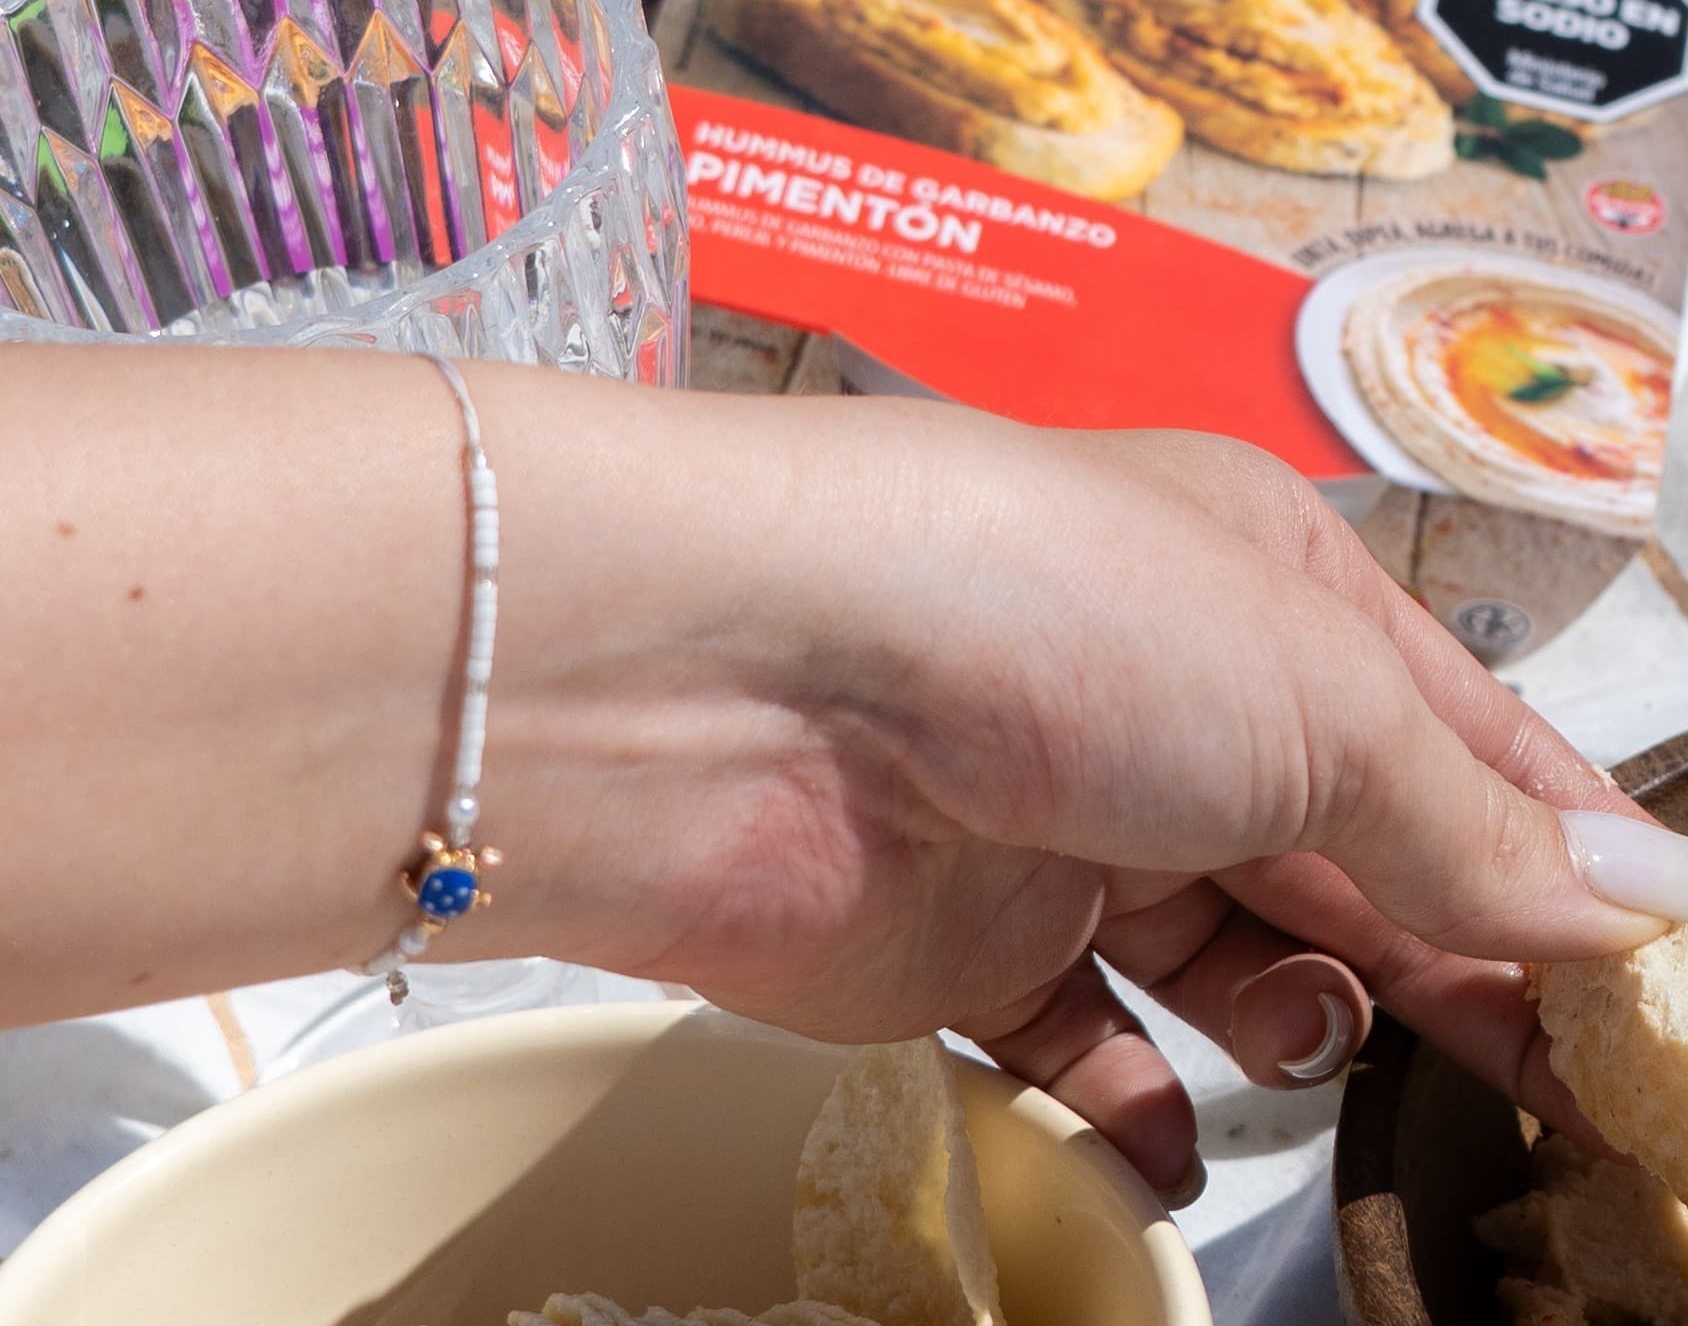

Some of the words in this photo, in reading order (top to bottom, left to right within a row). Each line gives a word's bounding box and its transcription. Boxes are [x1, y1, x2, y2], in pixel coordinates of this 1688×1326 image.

[686, 150, 984, 255] PIMENTÓN
[693, 120, 853, 180] HUMMUS
[857, 163, 905, 196] DE
[910, 177, 1118, 250] GARBANZO
